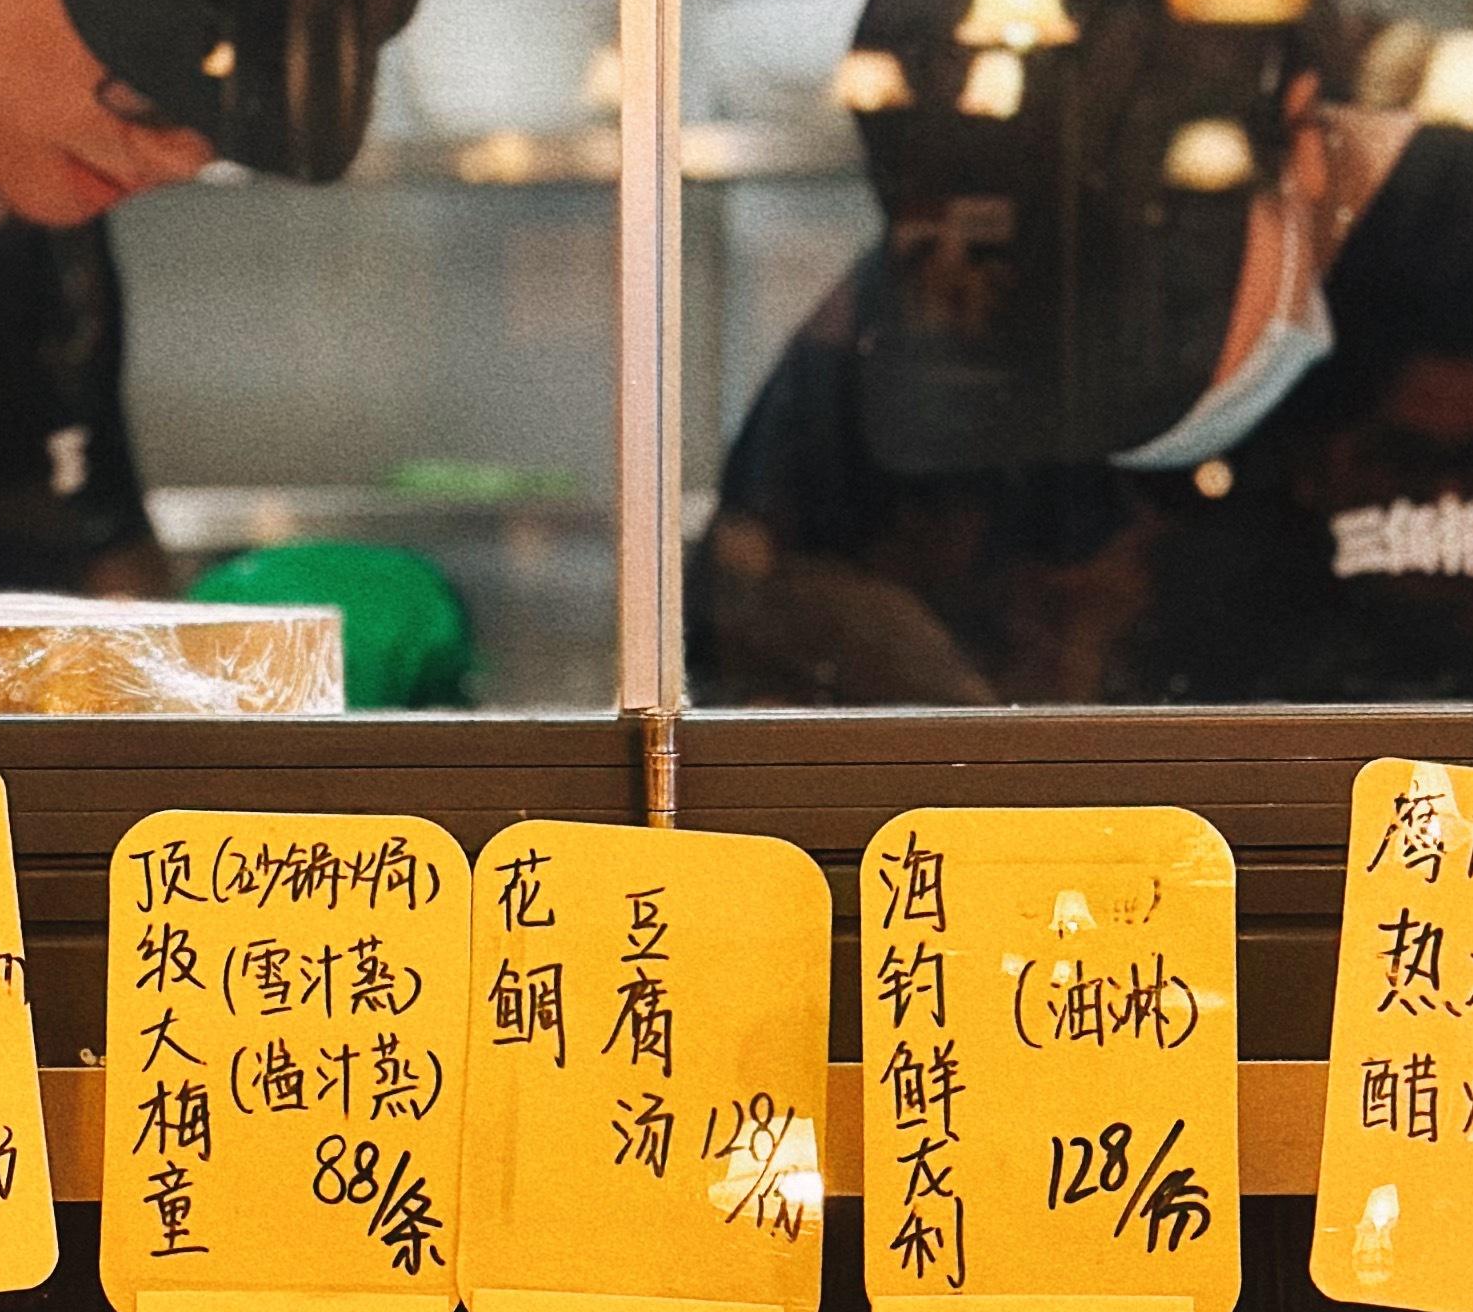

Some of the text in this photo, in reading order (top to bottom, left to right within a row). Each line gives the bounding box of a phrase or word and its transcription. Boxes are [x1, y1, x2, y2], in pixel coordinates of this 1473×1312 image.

[600, 886, 676, 1179] 豆腐汤
[312, 1133, 446, 1276] 88/条
[1047, 1118, 1212, 1254] 128/份
